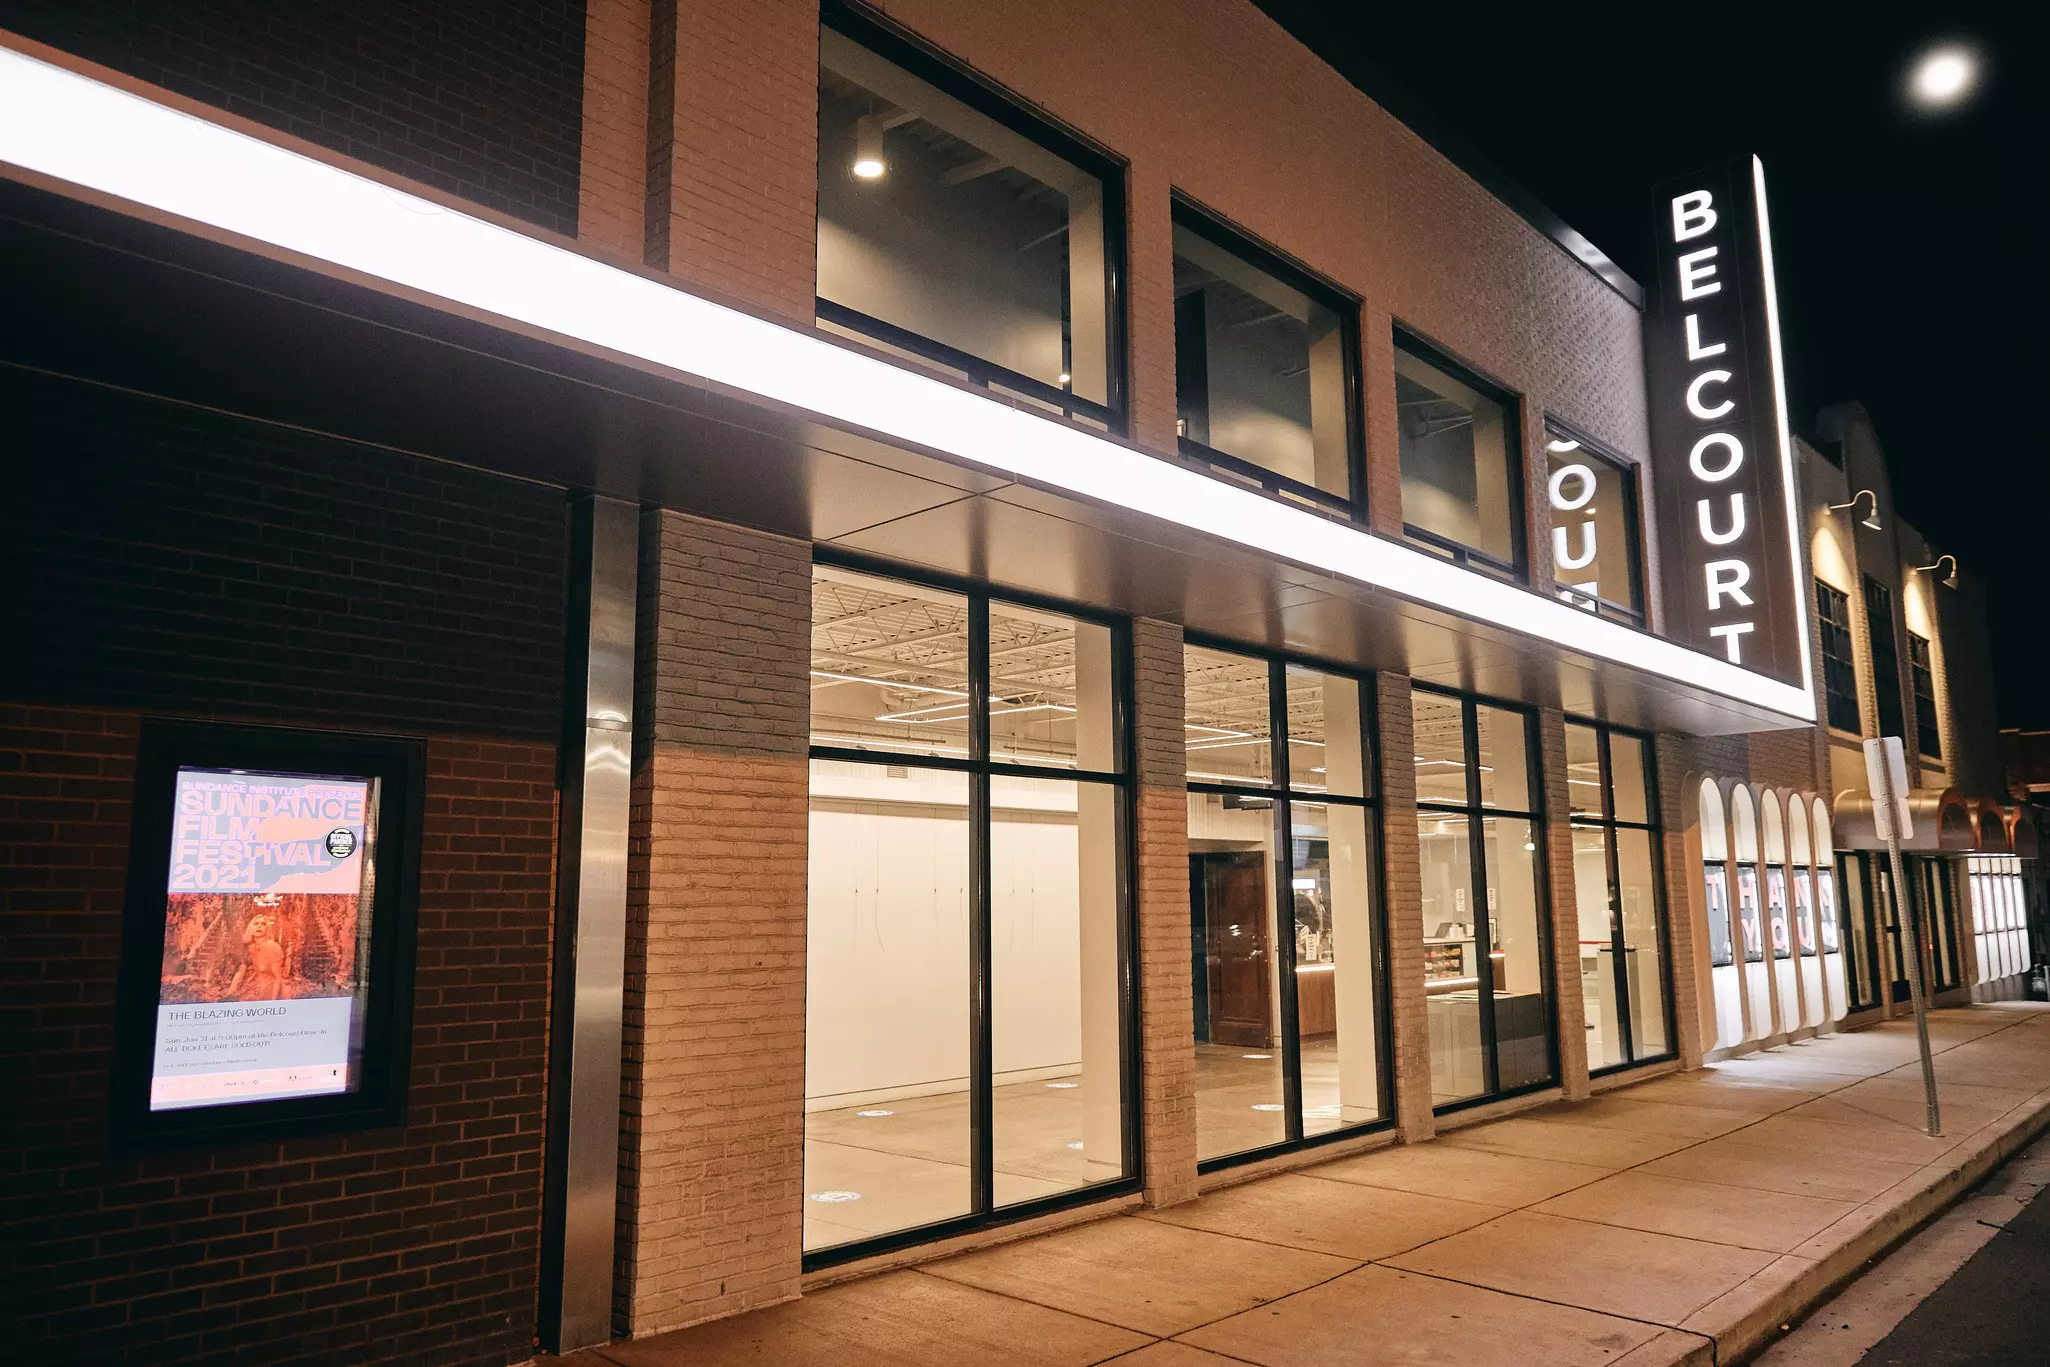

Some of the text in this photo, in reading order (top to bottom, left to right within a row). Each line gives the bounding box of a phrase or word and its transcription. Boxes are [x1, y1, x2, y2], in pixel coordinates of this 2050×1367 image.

[1672, 189, 1754, 664] BELCOURT
[182, 781, 363, 799] SUNDANCE INSTITUTE PRESENTS
[180, 791, 362, 820] SUNDANCE
[178, 814, 260, 841] FILM
[175, 839, 331, 866] FESTIVAL
[172, 863, 261, 889] 2021
[1741, 916, 1810, 952] YOU
[168, 1006, 287, 1020] THE BLAZING WORLD
